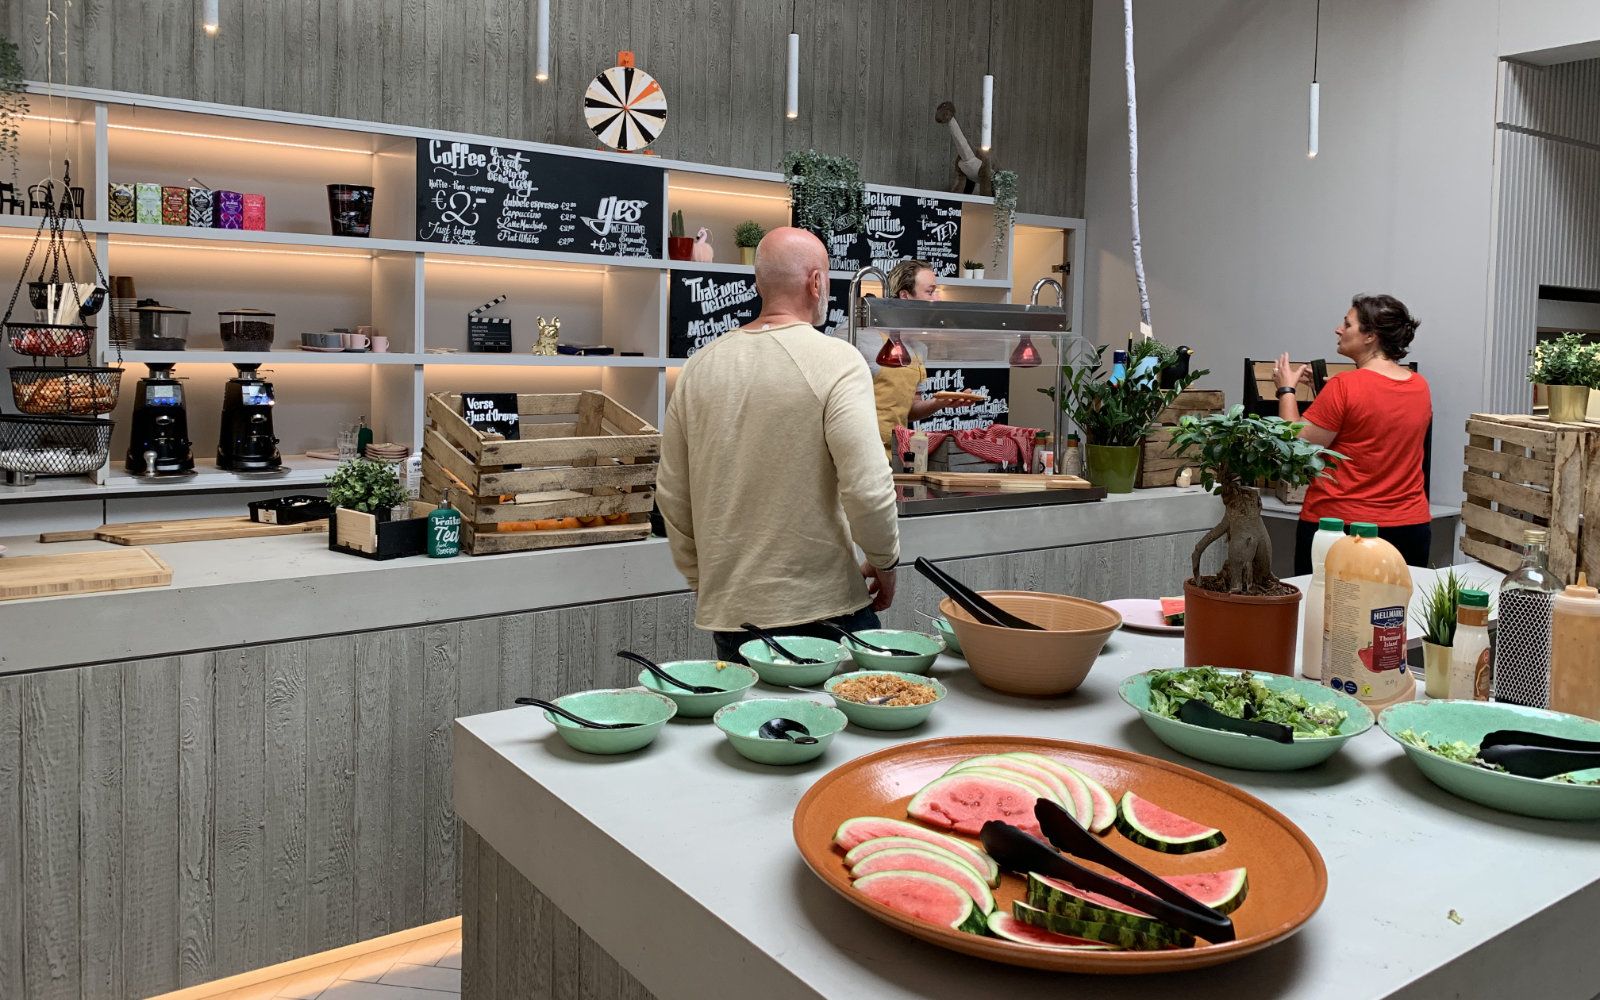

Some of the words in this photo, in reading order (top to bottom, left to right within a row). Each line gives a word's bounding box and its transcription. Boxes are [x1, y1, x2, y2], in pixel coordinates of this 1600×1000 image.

[429, 140, 487, 169] Coffee
[502, 206, 542, 219] Cappuccino
[530, 200, 559, 211] espresso
[420, 221, 451, 240] Just
[453, 225, 461, 235] to
[461, 226, 476, 238] keep
[518, 232, 540, 244] White
[682, 276, 718, 303] That
[687, 313, 740, 338] Michelle
[466, 397, 495, 410] Verse
[465, 410, 486, 426] Jus
[434, 525, 460, 543] Ted
